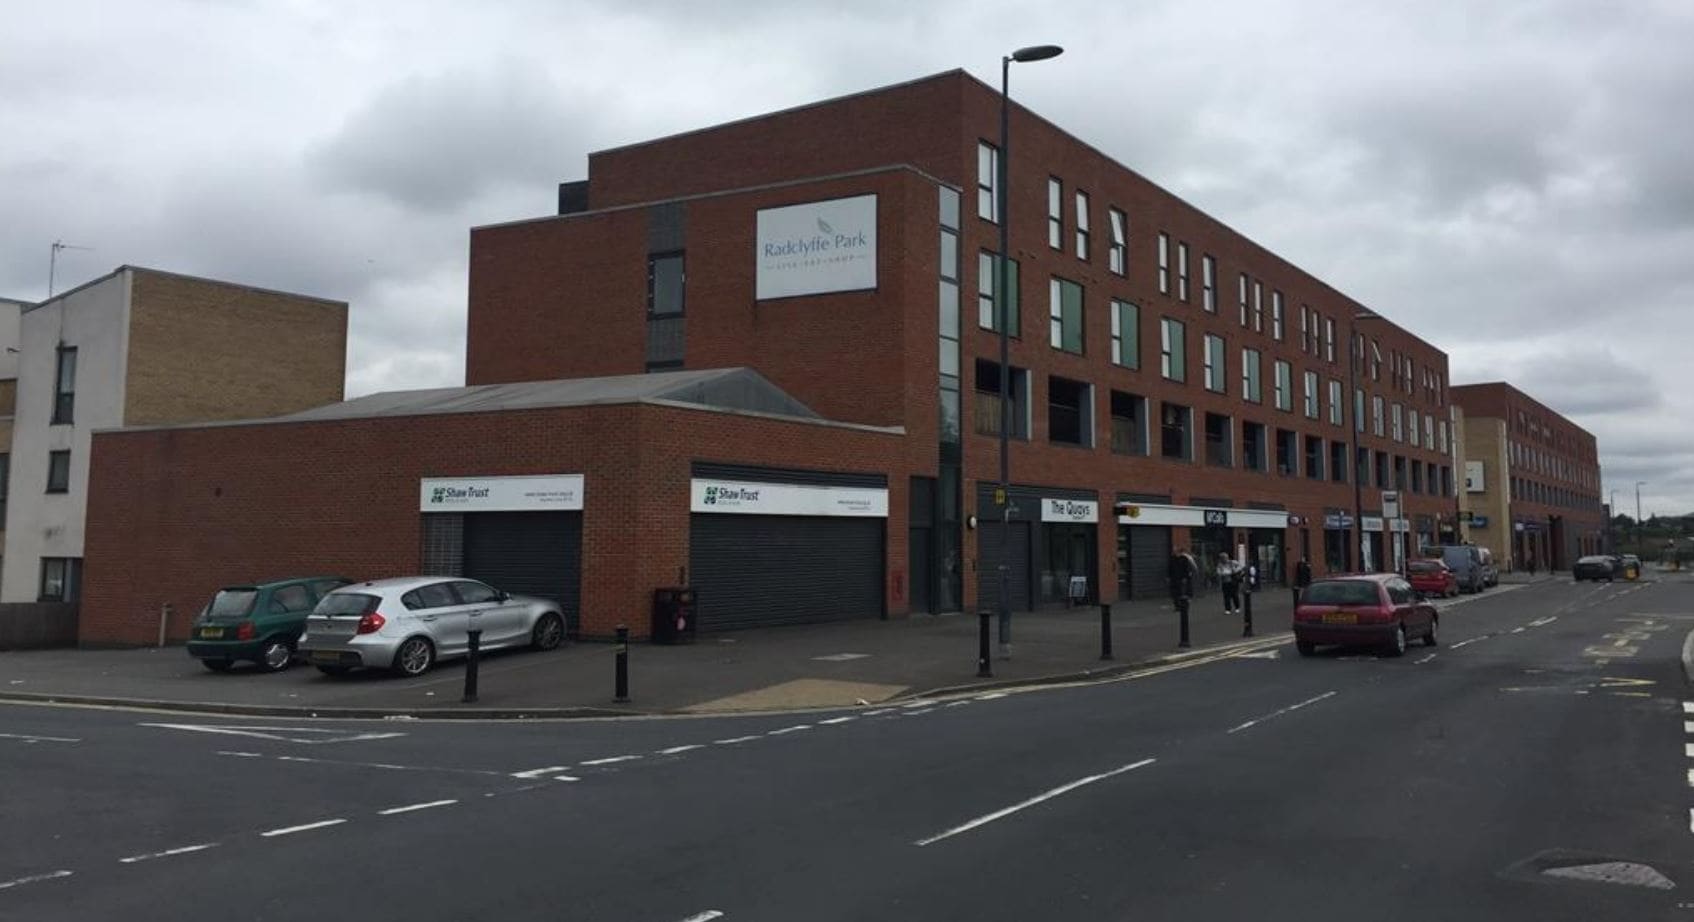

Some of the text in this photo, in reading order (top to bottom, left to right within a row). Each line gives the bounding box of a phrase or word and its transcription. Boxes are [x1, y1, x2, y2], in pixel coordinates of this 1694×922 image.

[764, 230, 867, 257] Radclyffe Park
[445, 486, 489, 498] Shaw Trust
[719, 487, 759, 501] Shaw Trust
[1051, 500, 1090, 516] The Quays
